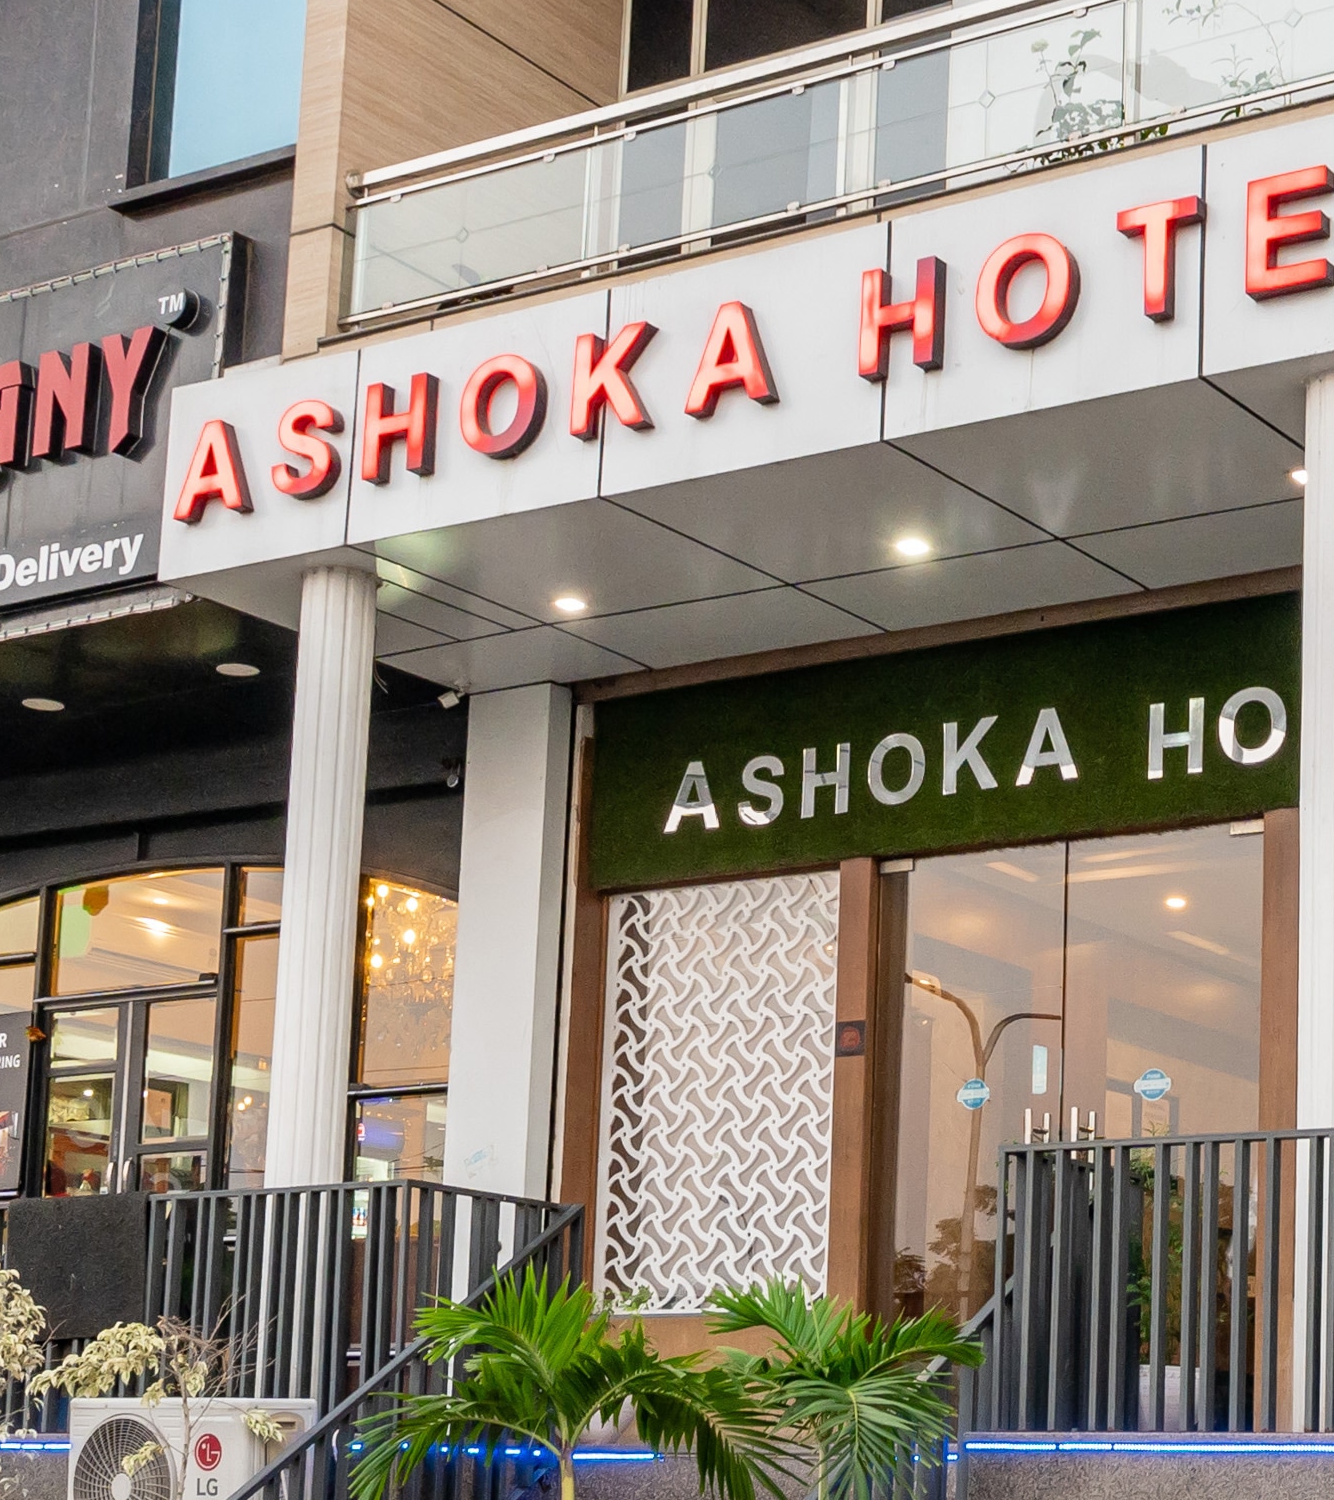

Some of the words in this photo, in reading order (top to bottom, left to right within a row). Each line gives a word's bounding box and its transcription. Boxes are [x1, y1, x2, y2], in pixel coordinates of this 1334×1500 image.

[173, 301, 777, 524] ASHOKA
[663, 707, 1079, 834] ASHOKA
[196, 1478, 218, 1496] LG
